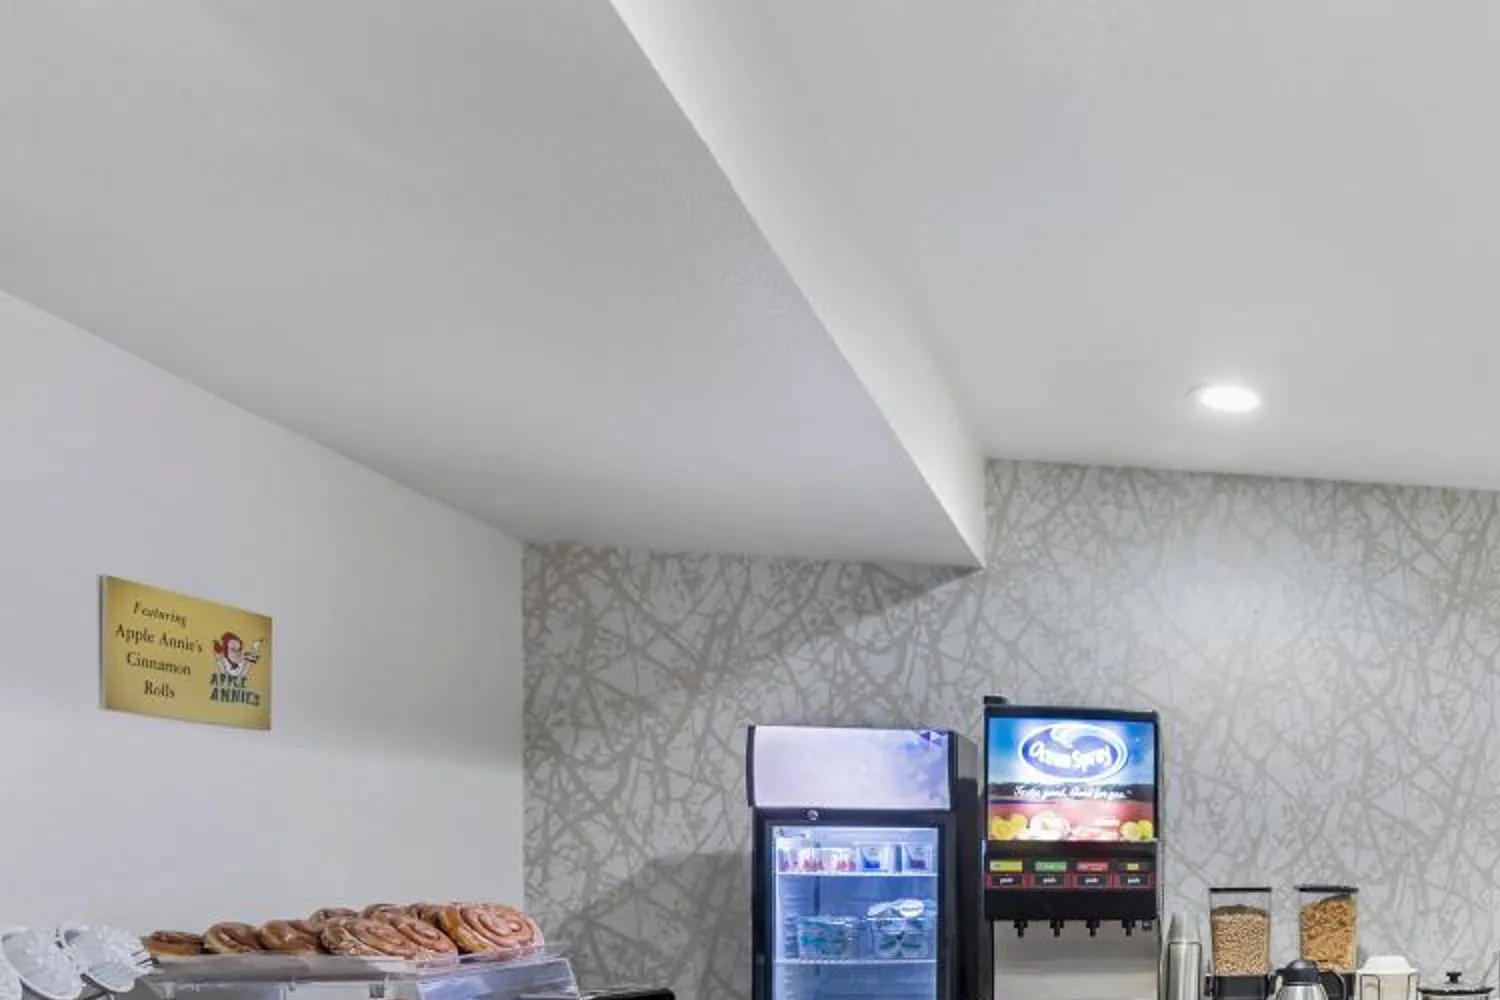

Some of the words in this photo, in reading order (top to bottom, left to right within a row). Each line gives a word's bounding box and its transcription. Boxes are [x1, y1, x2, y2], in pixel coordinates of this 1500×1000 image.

[133, 601, 187, 628] Featuring
[115, 624, 155, 643] Apple
[159, 632, 203, 652] Annie's
[126, 651, 192, 676] Cinnamon
[143, 679, 175, 699] Rolls
